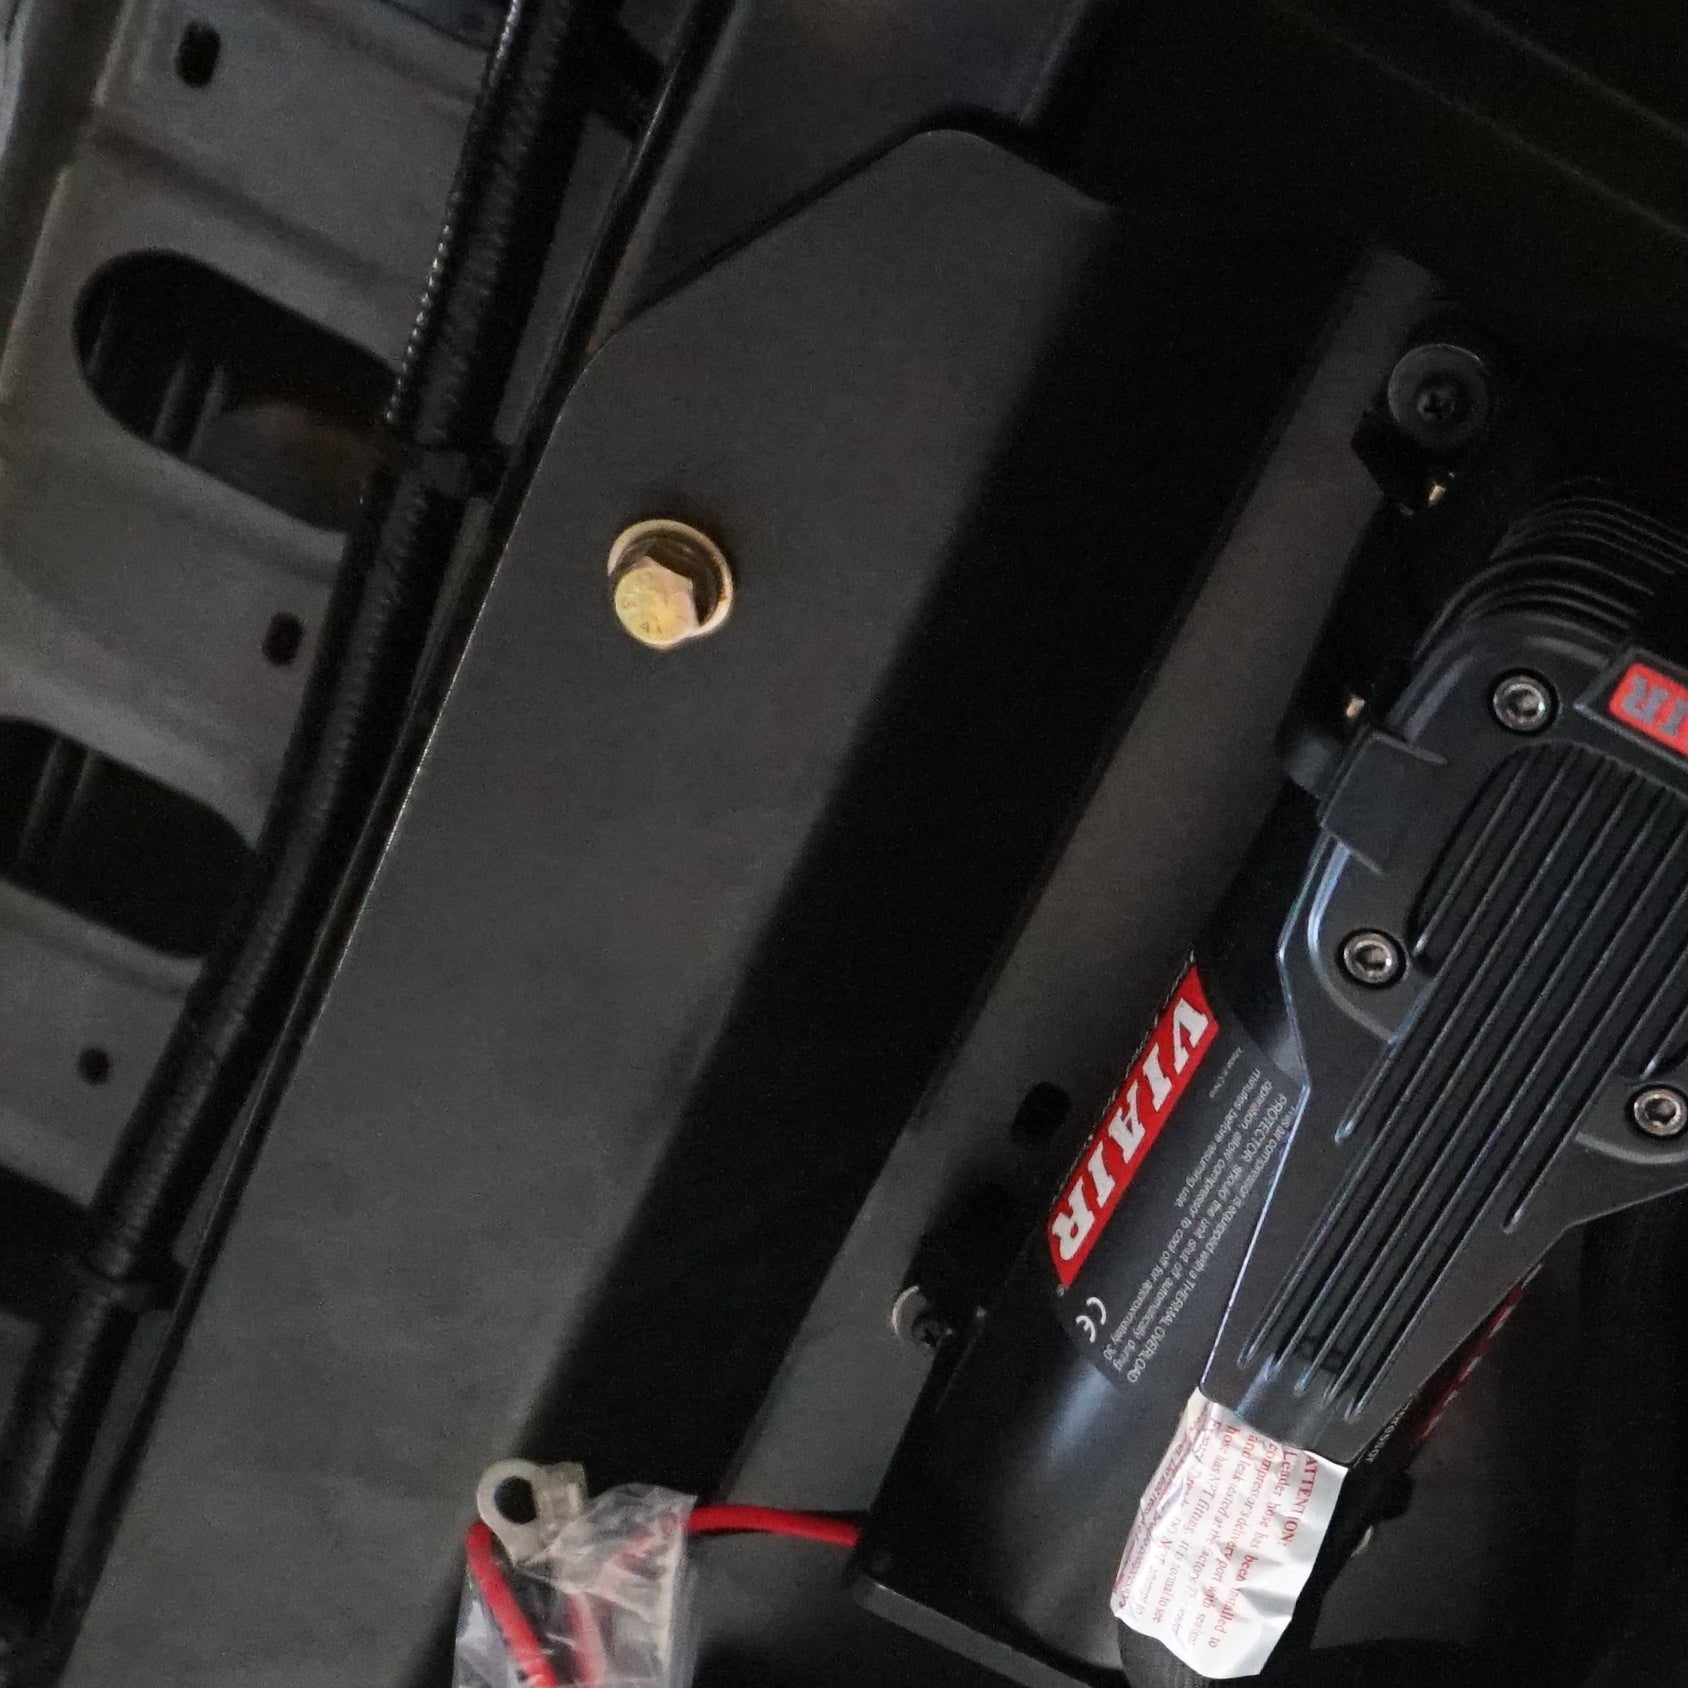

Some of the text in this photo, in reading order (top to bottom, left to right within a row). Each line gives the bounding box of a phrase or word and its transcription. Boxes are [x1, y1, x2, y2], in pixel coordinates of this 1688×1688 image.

[1231, 1067, 1263, 1110] minutes
[1052, 997, 1209, 1262] VIAIR
[1210, 1107, 1239, 1144] before
[1221, 1130, 1244, 1161] allow
[1182, 1140, 1218, 1189] resuming
[1236, 1137, 1279, 1199] compressor
[1186, 1158, 1227, 1219] compressor
[1215, 1162, 1242, 1200] should
[1165, 1227, 1185, 1252] cool
[1178, 1237, 1198, 1262] shut
[1148, 1264, 1164, 1282] for
[1156, 1250, 1172, 1267] off
[1168, 1261, 1185, 1279] off
[1191, 1249, 1211, 1273] with
[1108, 1278, 1154, 1345] approximately
[1130, 1276, 1175, 1340] automatically
[1157, 1277, 1196, 1329] THERMAL
[1101, 1342, 1117, 1360] 30
[1109, 1338, 1138, 1372] during
[1124, 1325, 1167, 1384] OVERLOAD
[1217, 1425, 1240, 1455] hose
[1241, 1433, 1258, 1459] and
[1209, 1454, 1228, 1474] has
[1231, 1459, 1251, 1483] leak
[1201, 1472, 1221, 1499] NPT
[1217, 1483, 1239, 1518] tested
[1276, 1455, 1319, 1548] ATTENTION:
[1211, 1515, 1224, 1528] at
[1207, 1450, 1298, 1649] Leader hose has been installed to
[1221, 1517, 1250, 1560] delivery
[1211, 1558, 1228, 1582] port
[1158, 1596, 1171, 1608] to
[1201, 1585, 1218, 1609] with
[1151, 1606, 1165, 1624] see
